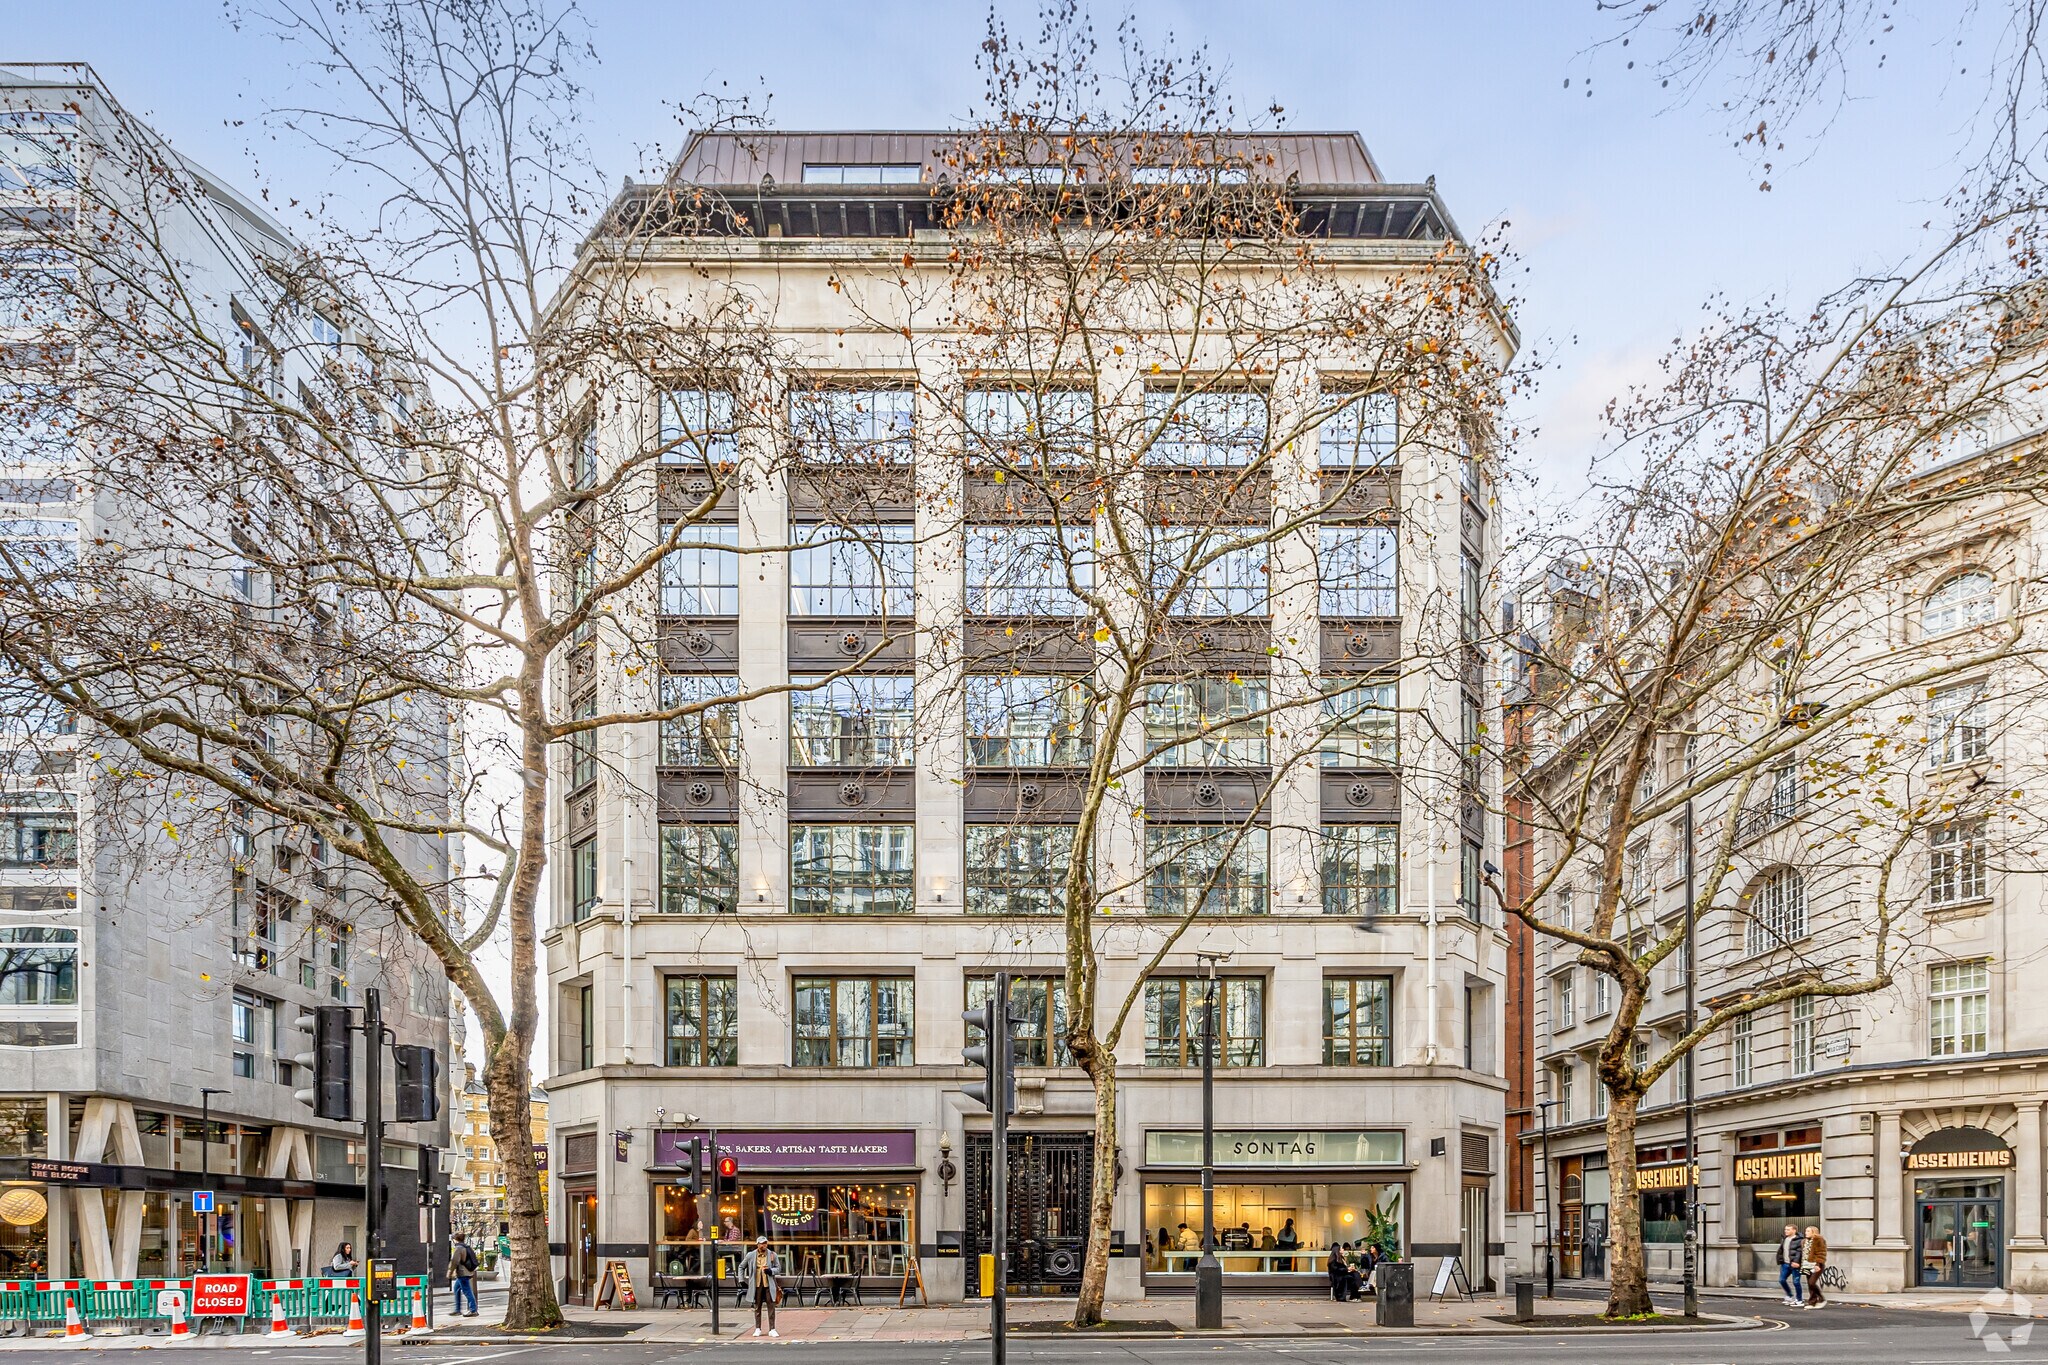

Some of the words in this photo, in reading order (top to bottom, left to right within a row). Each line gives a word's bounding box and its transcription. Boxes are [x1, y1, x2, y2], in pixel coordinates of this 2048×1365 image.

[775, 1145, 816, 1153] ARTISAN
[818, 1145, 848, 1153] TASTE
[849, 1145, 888, 1153] MAKERS
[1234, 1142, 1316, 1154] SONTAG
[1907, 1150, 2010, 1169] ASSENHEIMS
[31, 1162, 59, 1171] SPACE
[61, 1165, 89, 1174] HOUSE
[1735, 1152, 1822, 1181] ASSENHEIMS
[31, 1170, 48, 1178] THE
[50, 1171, 79, 1180] BLOCK
[1635, 1165, 1700, 1189] ASSENHEIS
[766, 1194, 816, 1211] SOHO
[771, 1214, 800, 1226] COFFEE
[204, 1284, 237, 1293] ROAD
[196, 1298, 244, 1308] CLOSED
